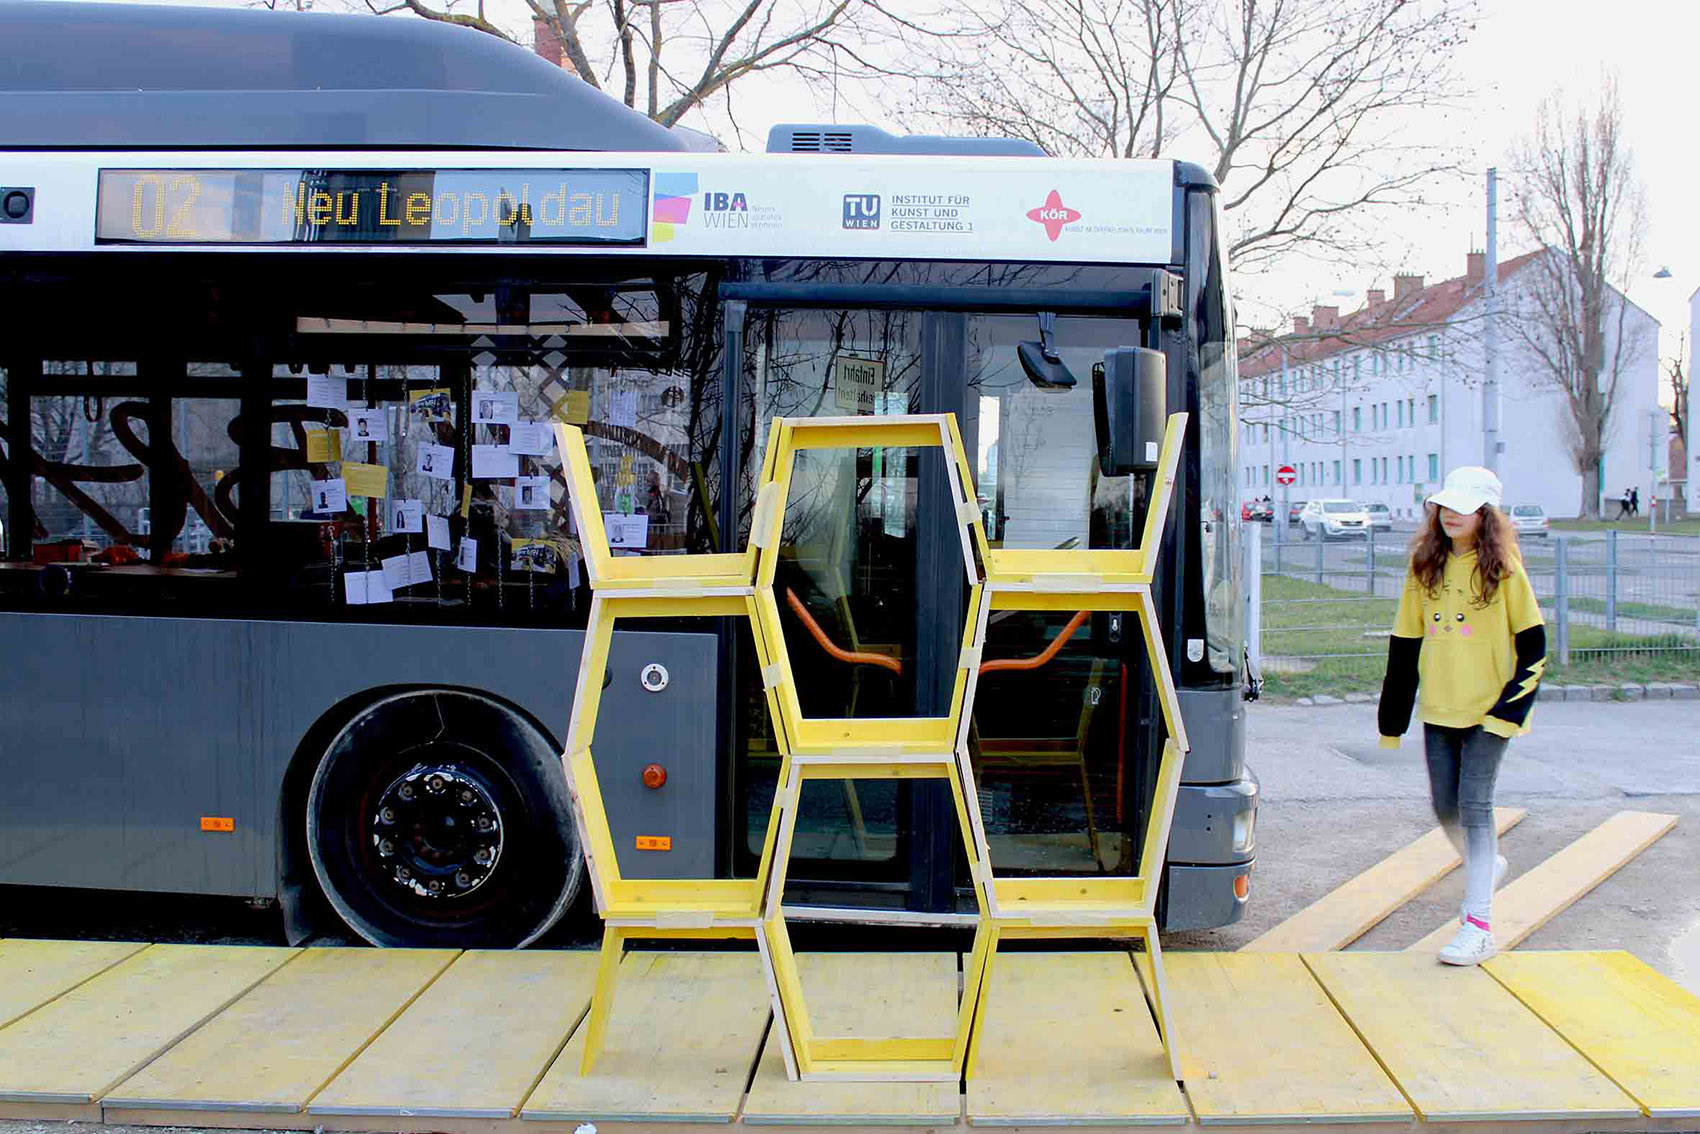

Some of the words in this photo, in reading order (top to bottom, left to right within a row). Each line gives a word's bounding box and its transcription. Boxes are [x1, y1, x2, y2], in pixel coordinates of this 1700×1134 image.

[132, 176, 200, 237] 02
[281, 181, 359, 226] Neu
[379, 181, 620, 235] Leopoldau
[704, 192, 748, 211] IBA
[892, 195, 943, 205] INSTITUT
[845, 197, 878, 217] TU
[891, 208, 929, 218] KUNST
[934, 209, 959, 218] UND
[1040, 207, 1068, 220] KÖR
[703, 212, 749, 229] WIEN
[845, 219, 878, 228] WIEN
[890, 221, 964, 231] GESTALTUNG
[968, 222, 974, 231] 1
